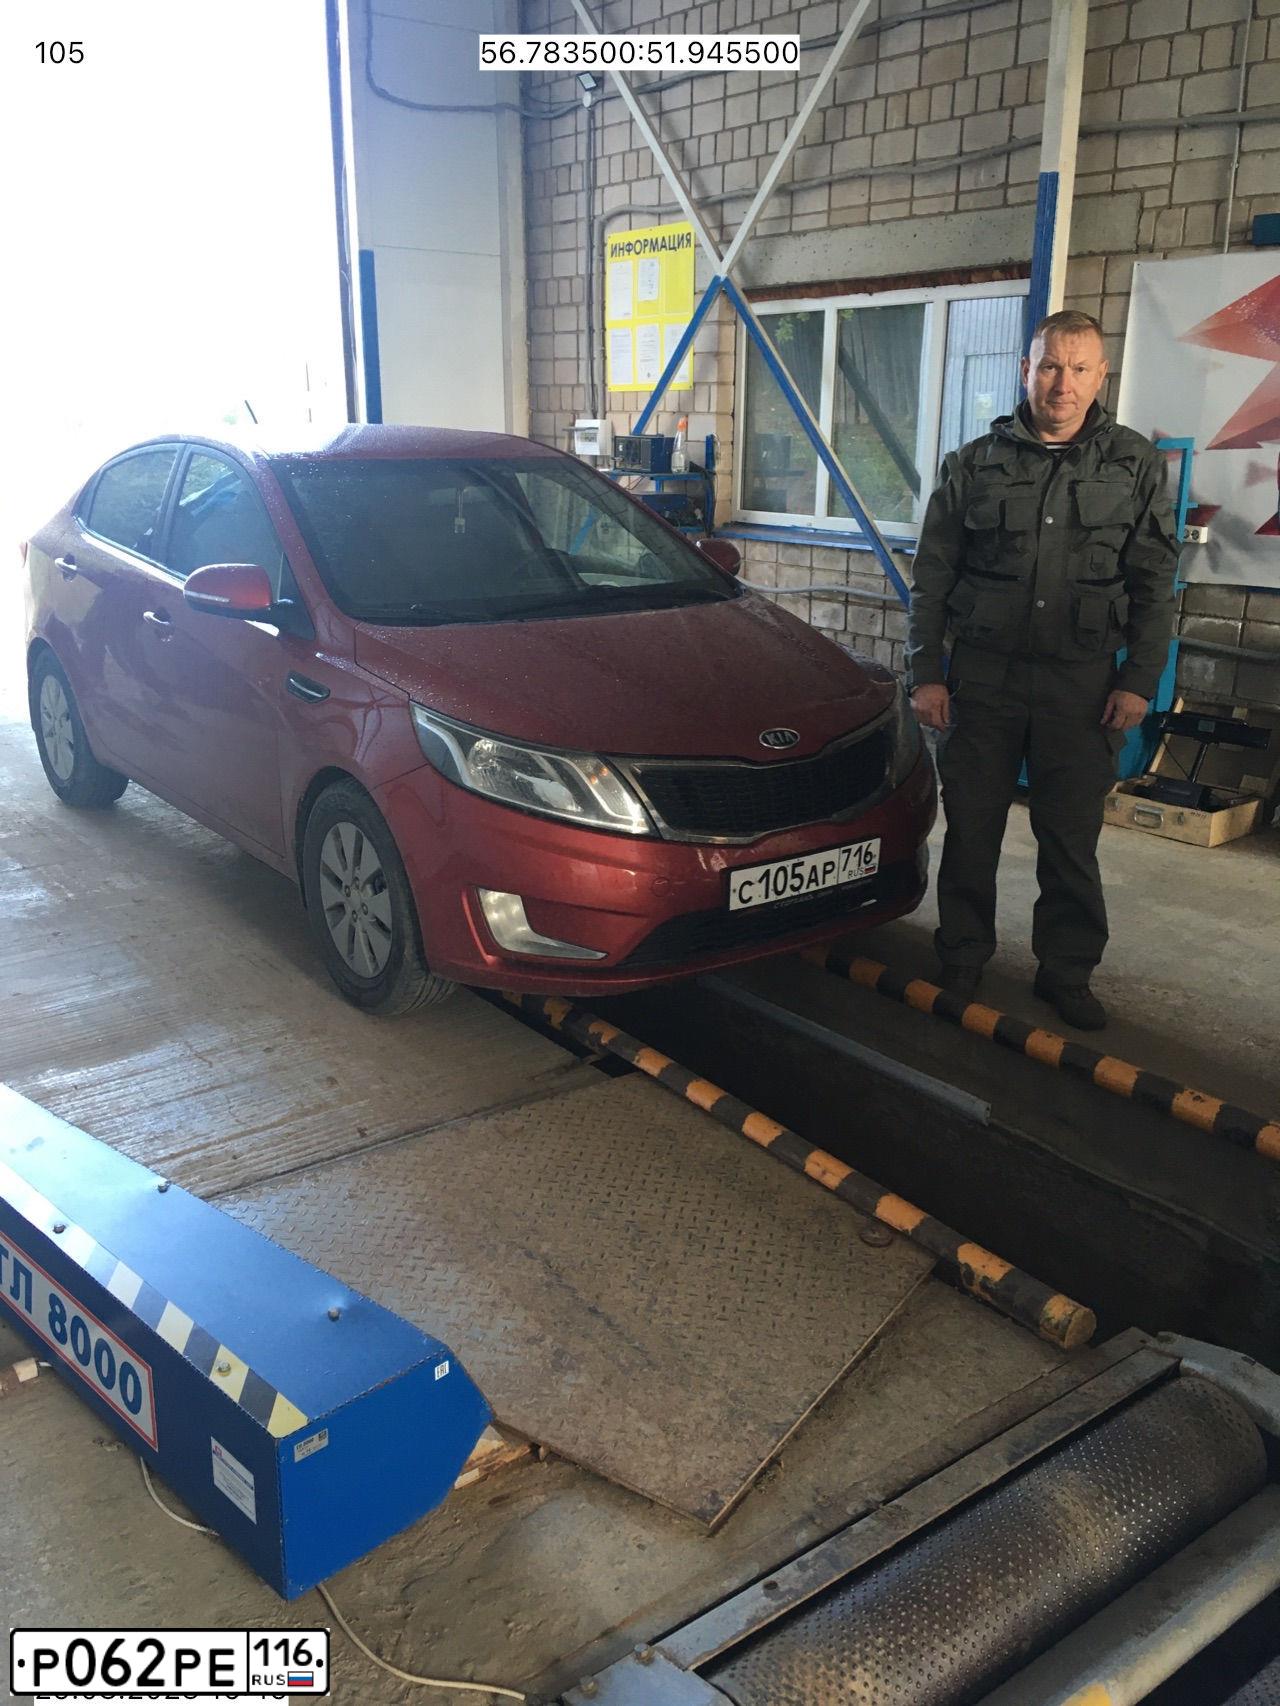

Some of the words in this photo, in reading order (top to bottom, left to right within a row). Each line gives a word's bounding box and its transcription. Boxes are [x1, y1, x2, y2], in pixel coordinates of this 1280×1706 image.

[610, 232, 692, 258] ИНФОРМАЦИЯ
[765, 731, 796, 745] KIA
[841, 842, 873, 872] 716
[847, 867, 865, 879] RUS
[48, 1292, 142, 1416] 8000
